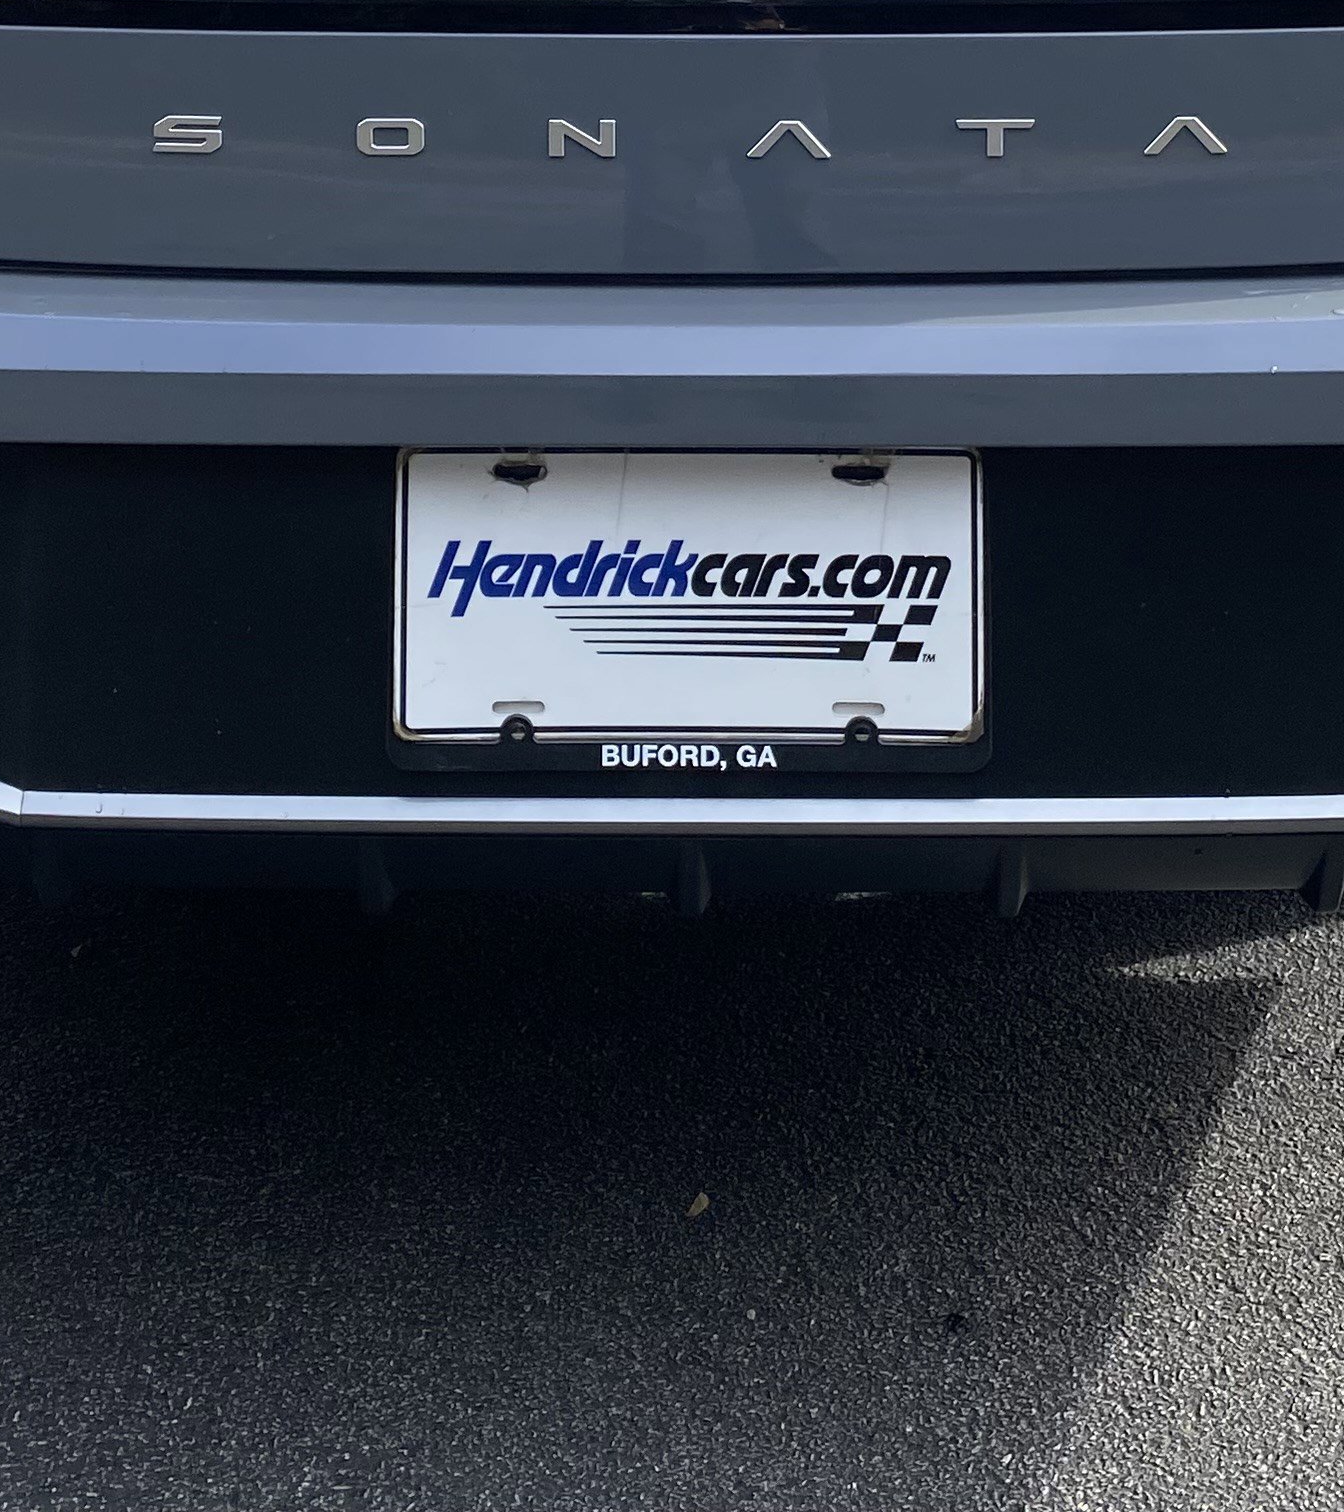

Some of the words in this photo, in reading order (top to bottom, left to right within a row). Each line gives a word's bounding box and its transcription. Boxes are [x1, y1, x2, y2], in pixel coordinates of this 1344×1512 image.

[427, 539, 952, 617] Hendrickcars.com
[601, 744, 727, 771] BUFORD,
[737, 744, 778, 769] GA
